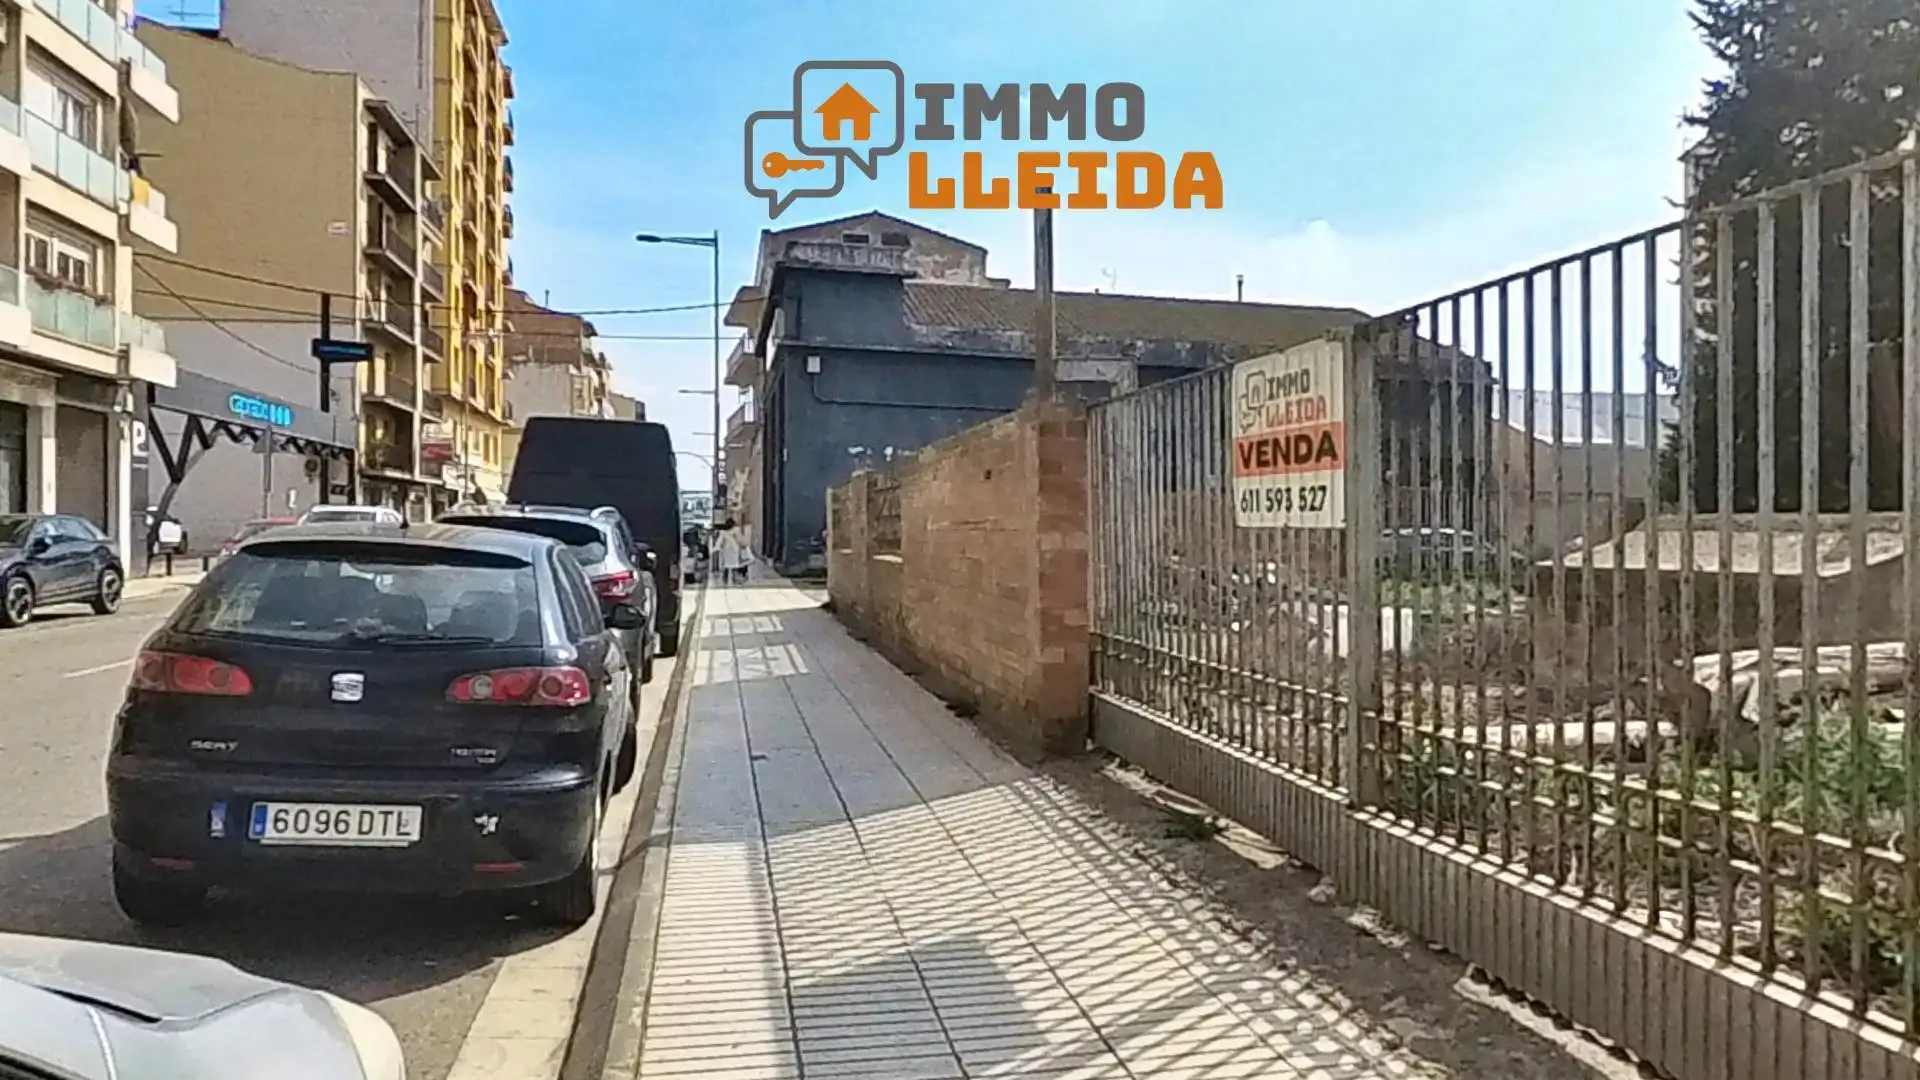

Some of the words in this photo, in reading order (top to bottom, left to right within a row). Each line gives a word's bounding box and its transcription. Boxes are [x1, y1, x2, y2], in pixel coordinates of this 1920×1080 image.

[1266, 368, 1311, 401] IMMO
[1265, 395, 1328, 428] LLEIDA
[1238, 430, 1339, 470] VENDA
[1240, 488, 1261, 514] 611
[1265, 486, 1293, 513] 593
[1299, 485, 1328, 512] 527
[272, 808, 351, 835] 6096
[357, 810, 412, 836] DTL
